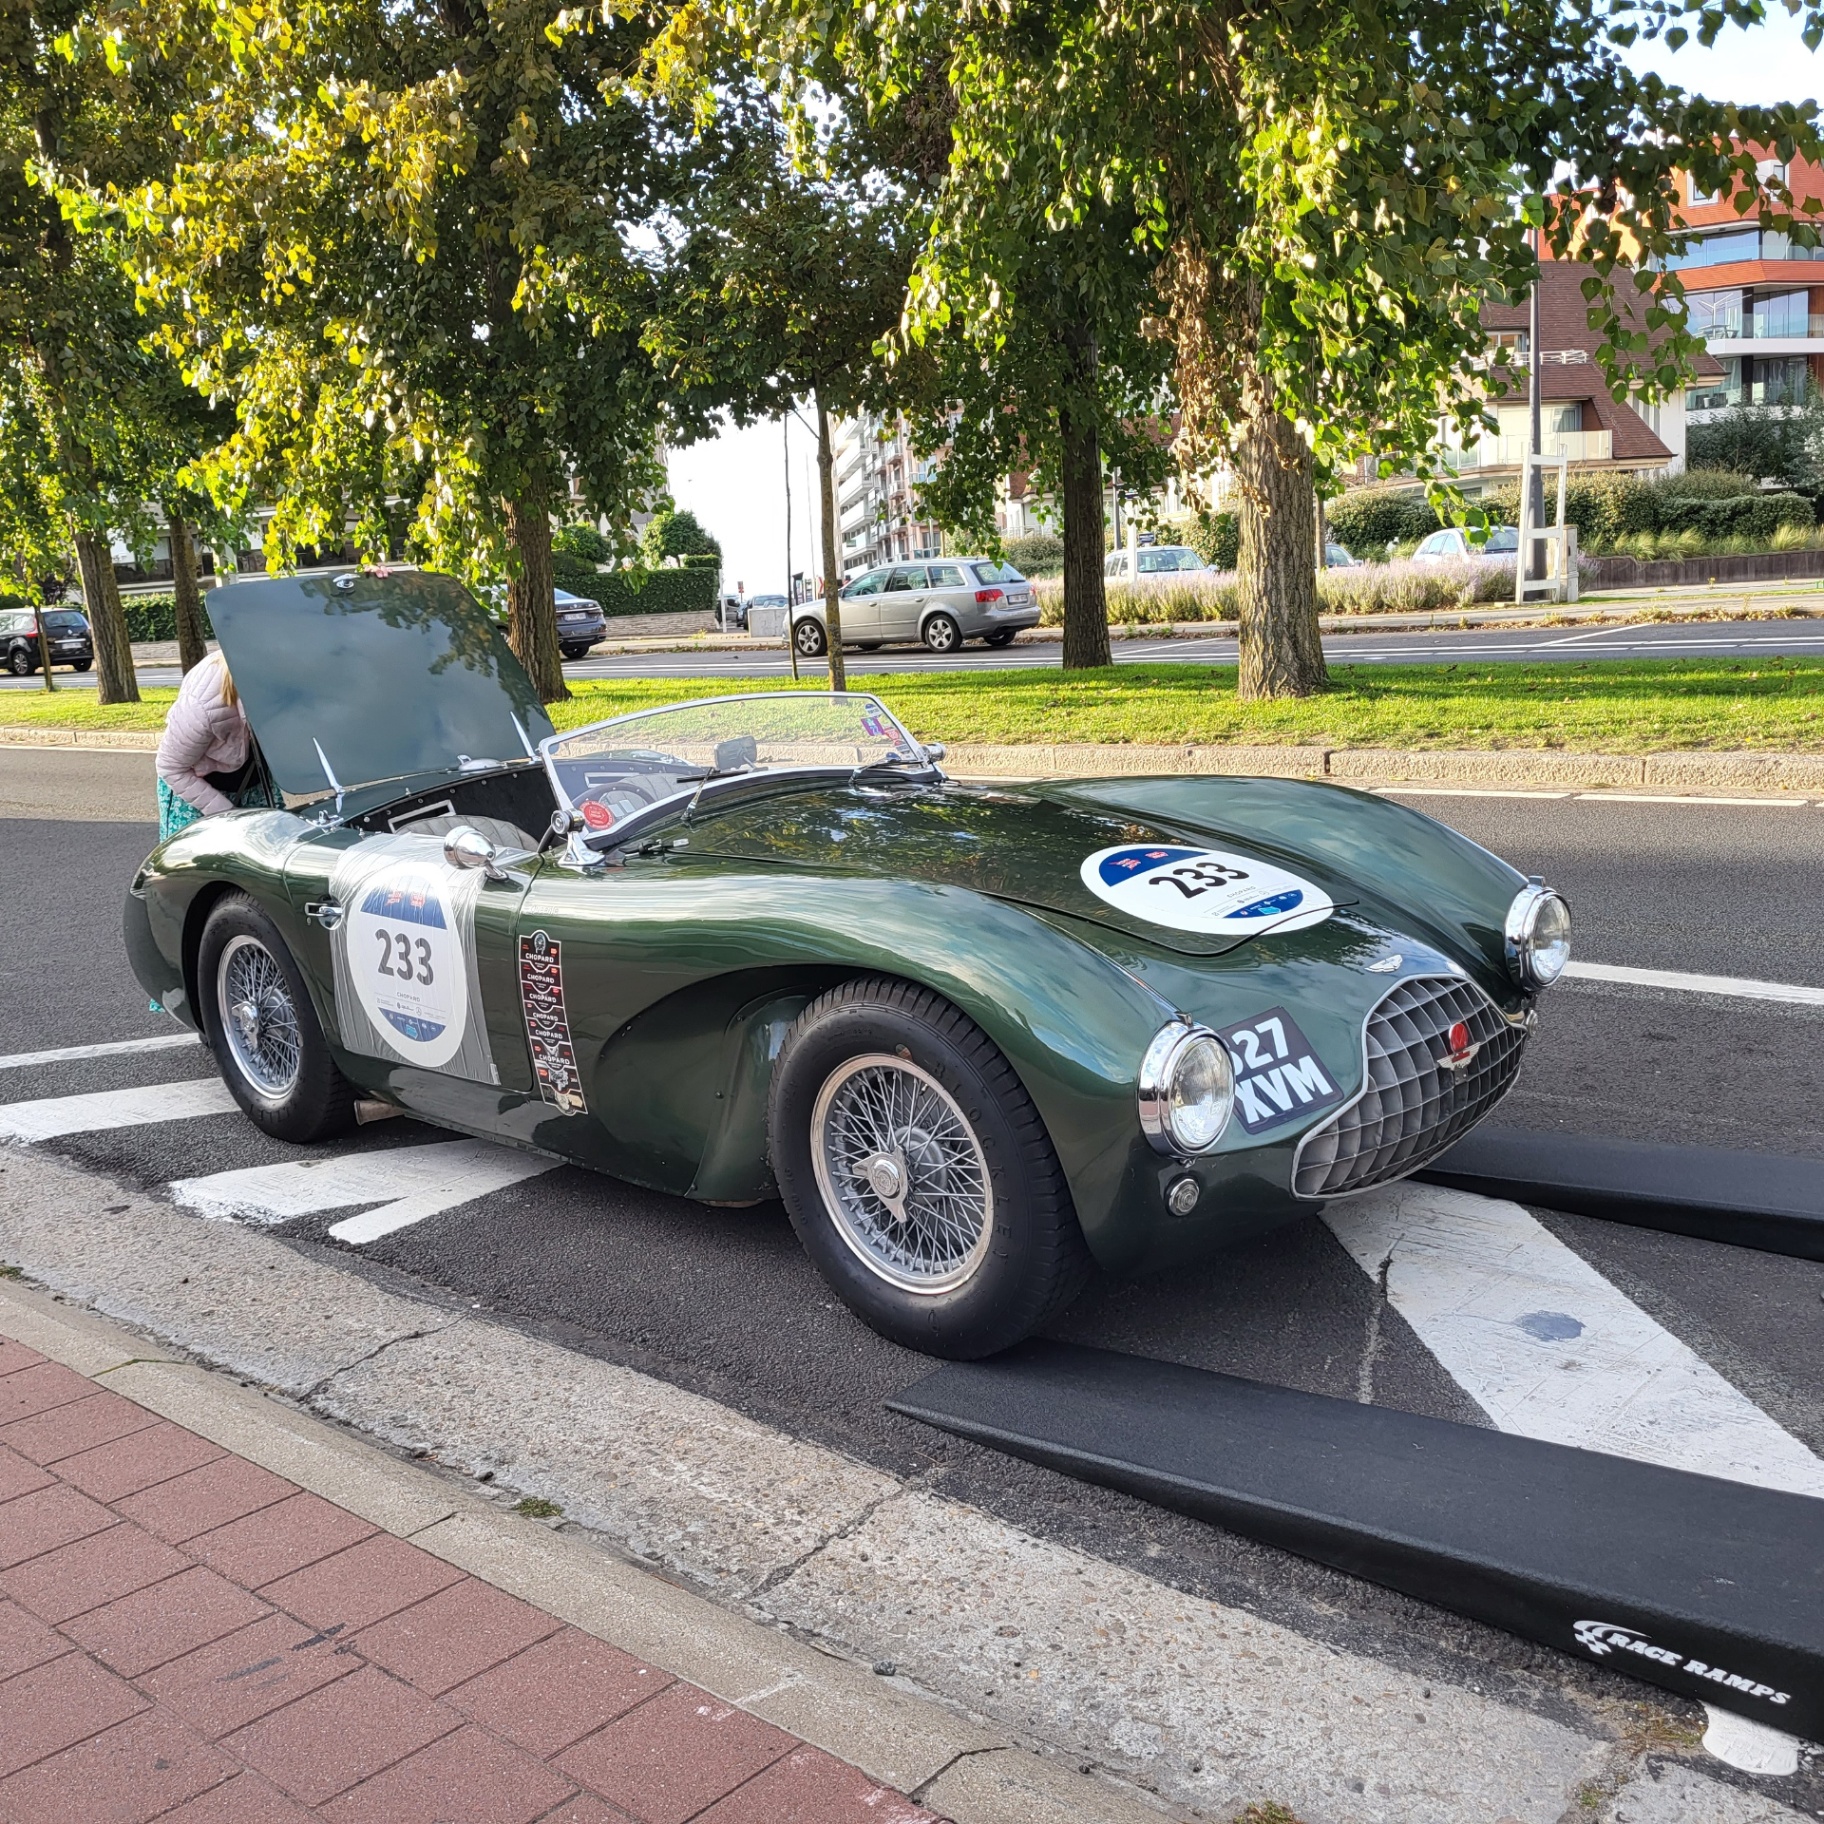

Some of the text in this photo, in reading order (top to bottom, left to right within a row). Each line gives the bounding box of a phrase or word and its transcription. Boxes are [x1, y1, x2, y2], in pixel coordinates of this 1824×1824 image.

[1148, 862, 1250, 899] 233
[374, 928, 434, 986] 233
[525, 952, 554, 963] CHOPARD
[527, 973, 555, 984] CHOPARD
[396, 991, 421, 1002] CHOPARD
[529, 993, 557, 1003] CHOPARD
[532, 1012, 559, 1021] CHOPARD
[535, 1029, 563, 1039] CHOPARD
[539, 1054, 570, 1065] CHOPARD
[1235, 1055, 1333, 1124] XVM
[1606, 1632, 1792, 1705] RACE RAMPS
